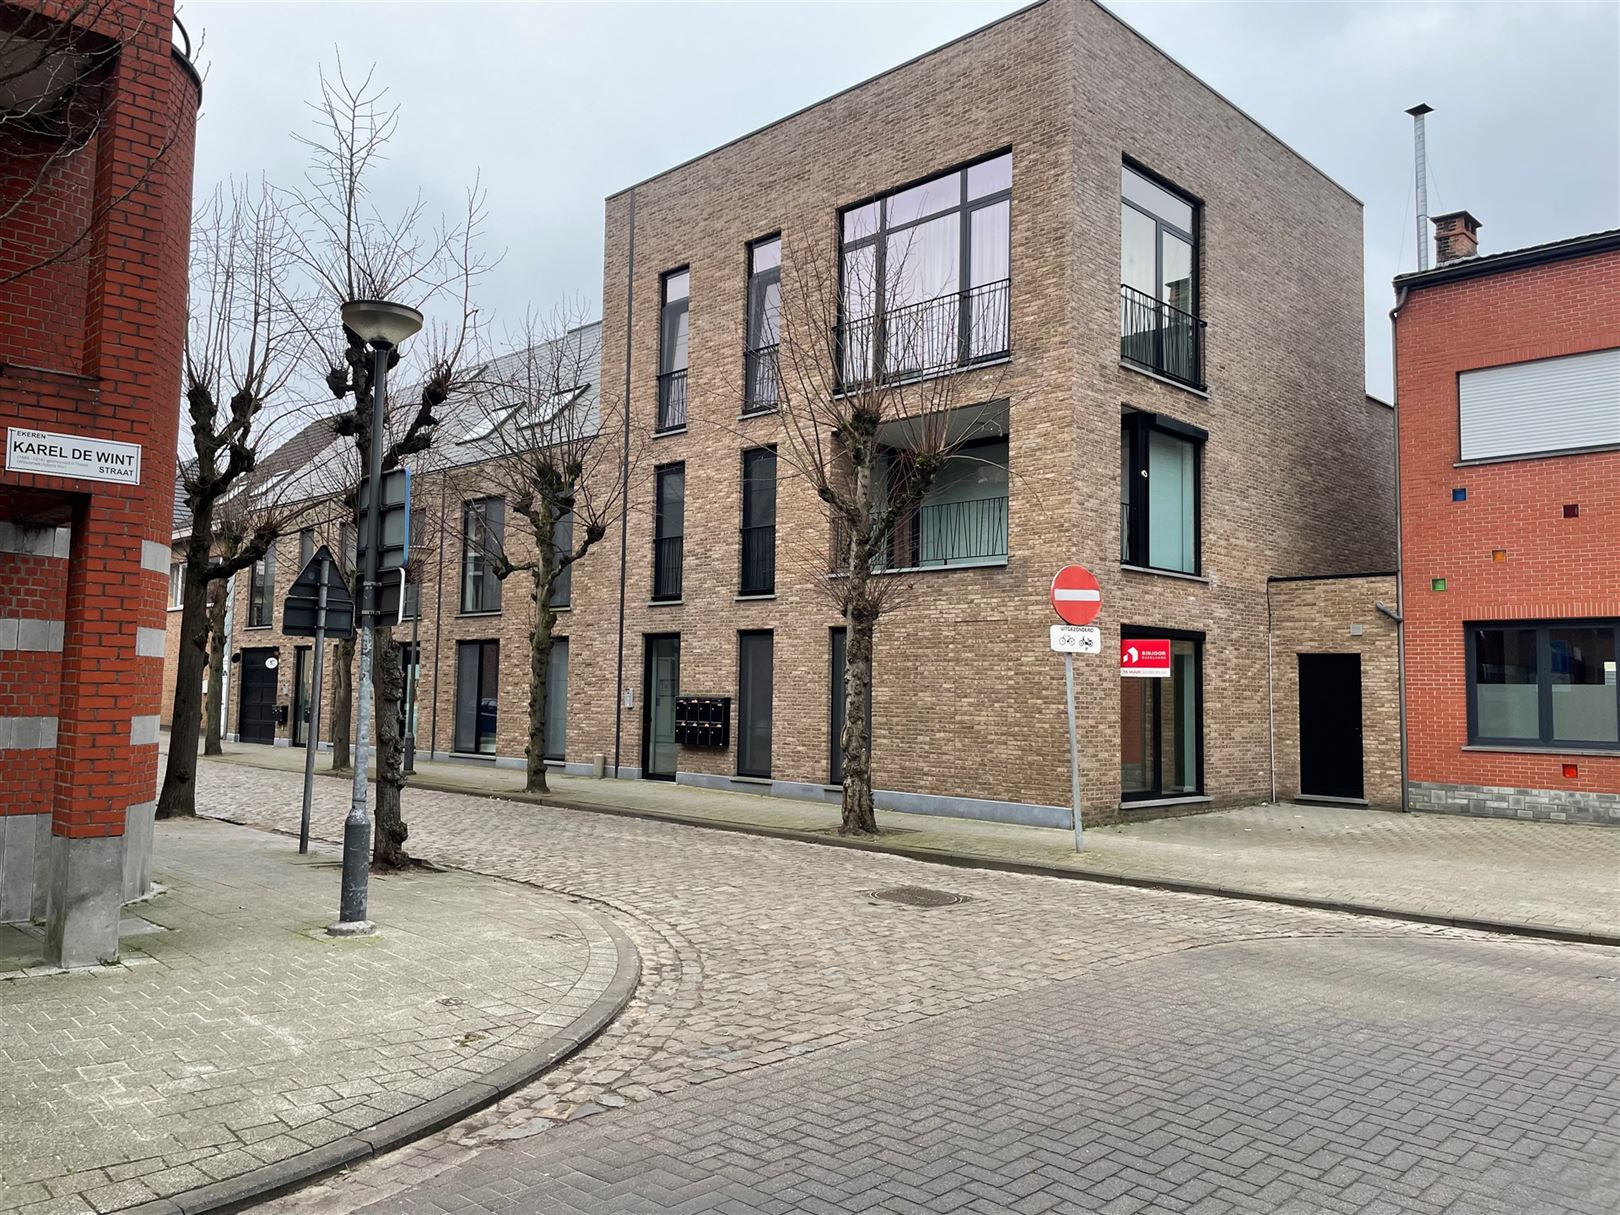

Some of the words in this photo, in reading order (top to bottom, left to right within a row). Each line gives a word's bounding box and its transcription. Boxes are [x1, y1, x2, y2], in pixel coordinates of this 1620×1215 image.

[17, 430, 46, 439] EKEREN
[13, 441, 68, 459] KAREL
[72, 448, 93, 461] DE
[96, 451, 135, 466] WINT
[98, 466, 134, 477] STRAAT
